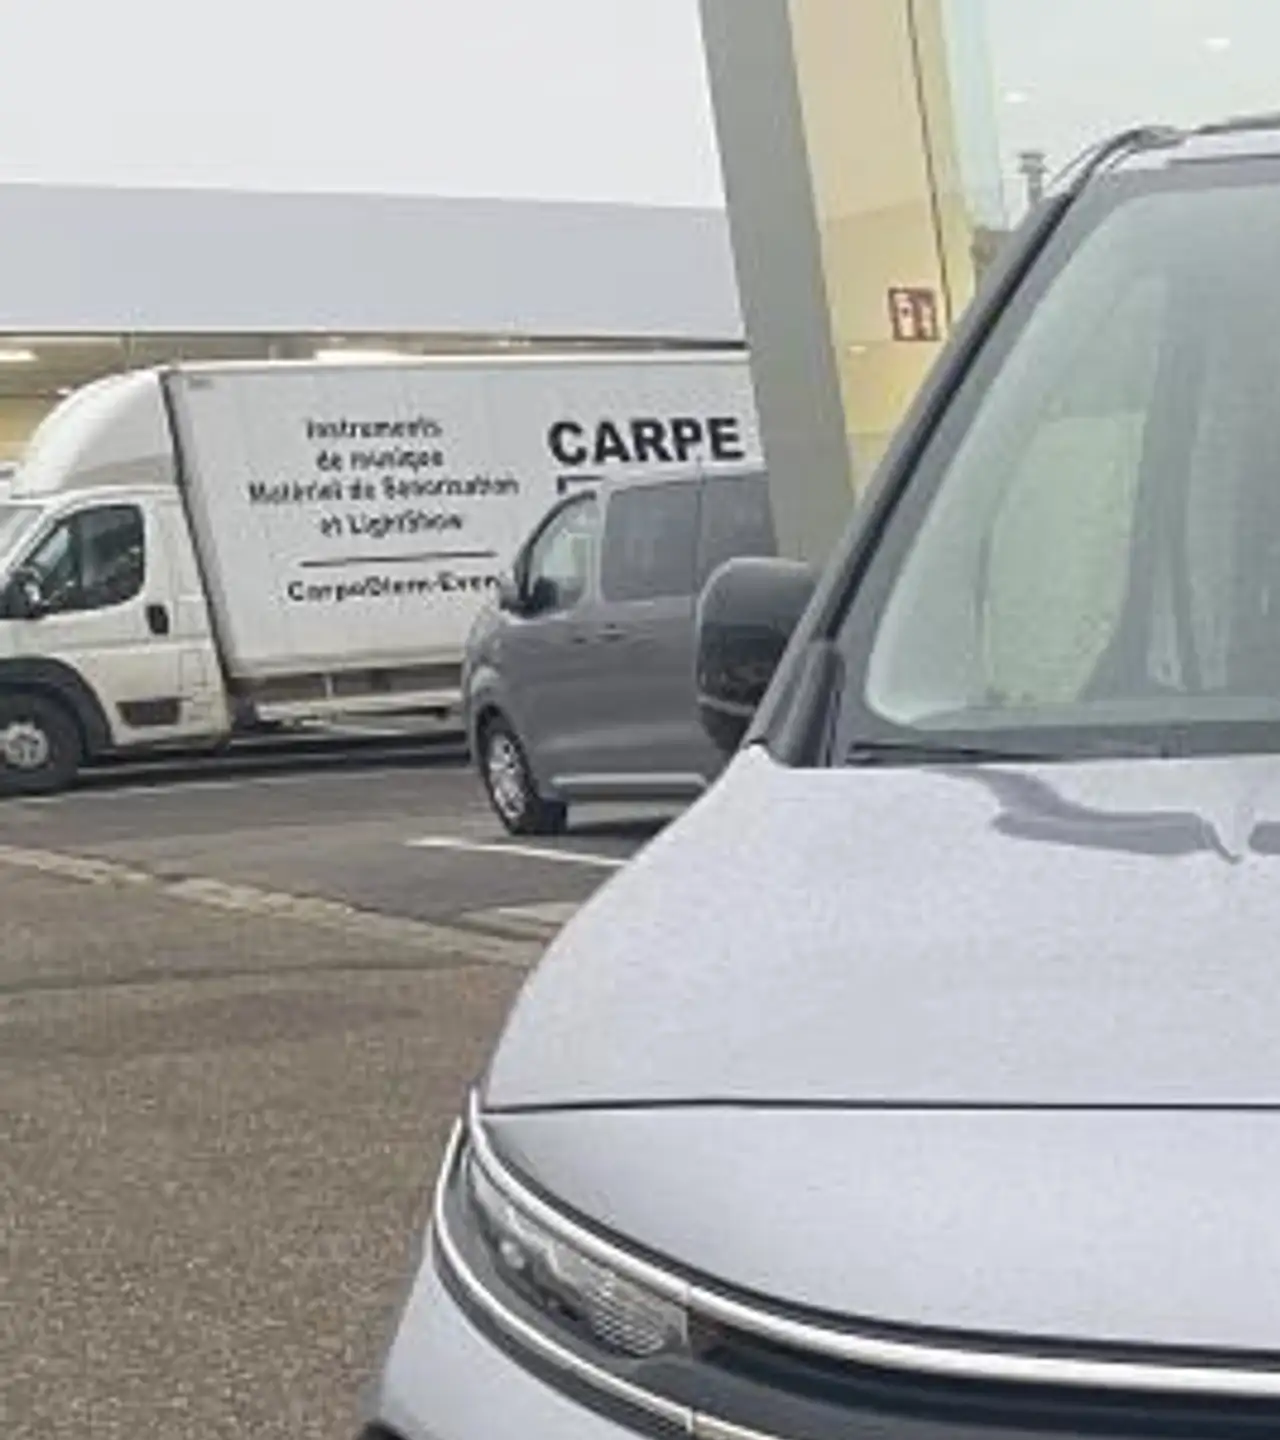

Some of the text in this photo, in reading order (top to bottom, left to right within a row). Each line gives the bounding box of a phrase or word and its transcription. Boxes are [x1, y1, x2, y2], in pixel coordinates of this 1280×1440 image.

[306, 418, 442, 439] Instruments
[549, 417, 745, 466] CARPE
[316, 447, 444, 472] de musique
[349, 477, 376, 500] de
